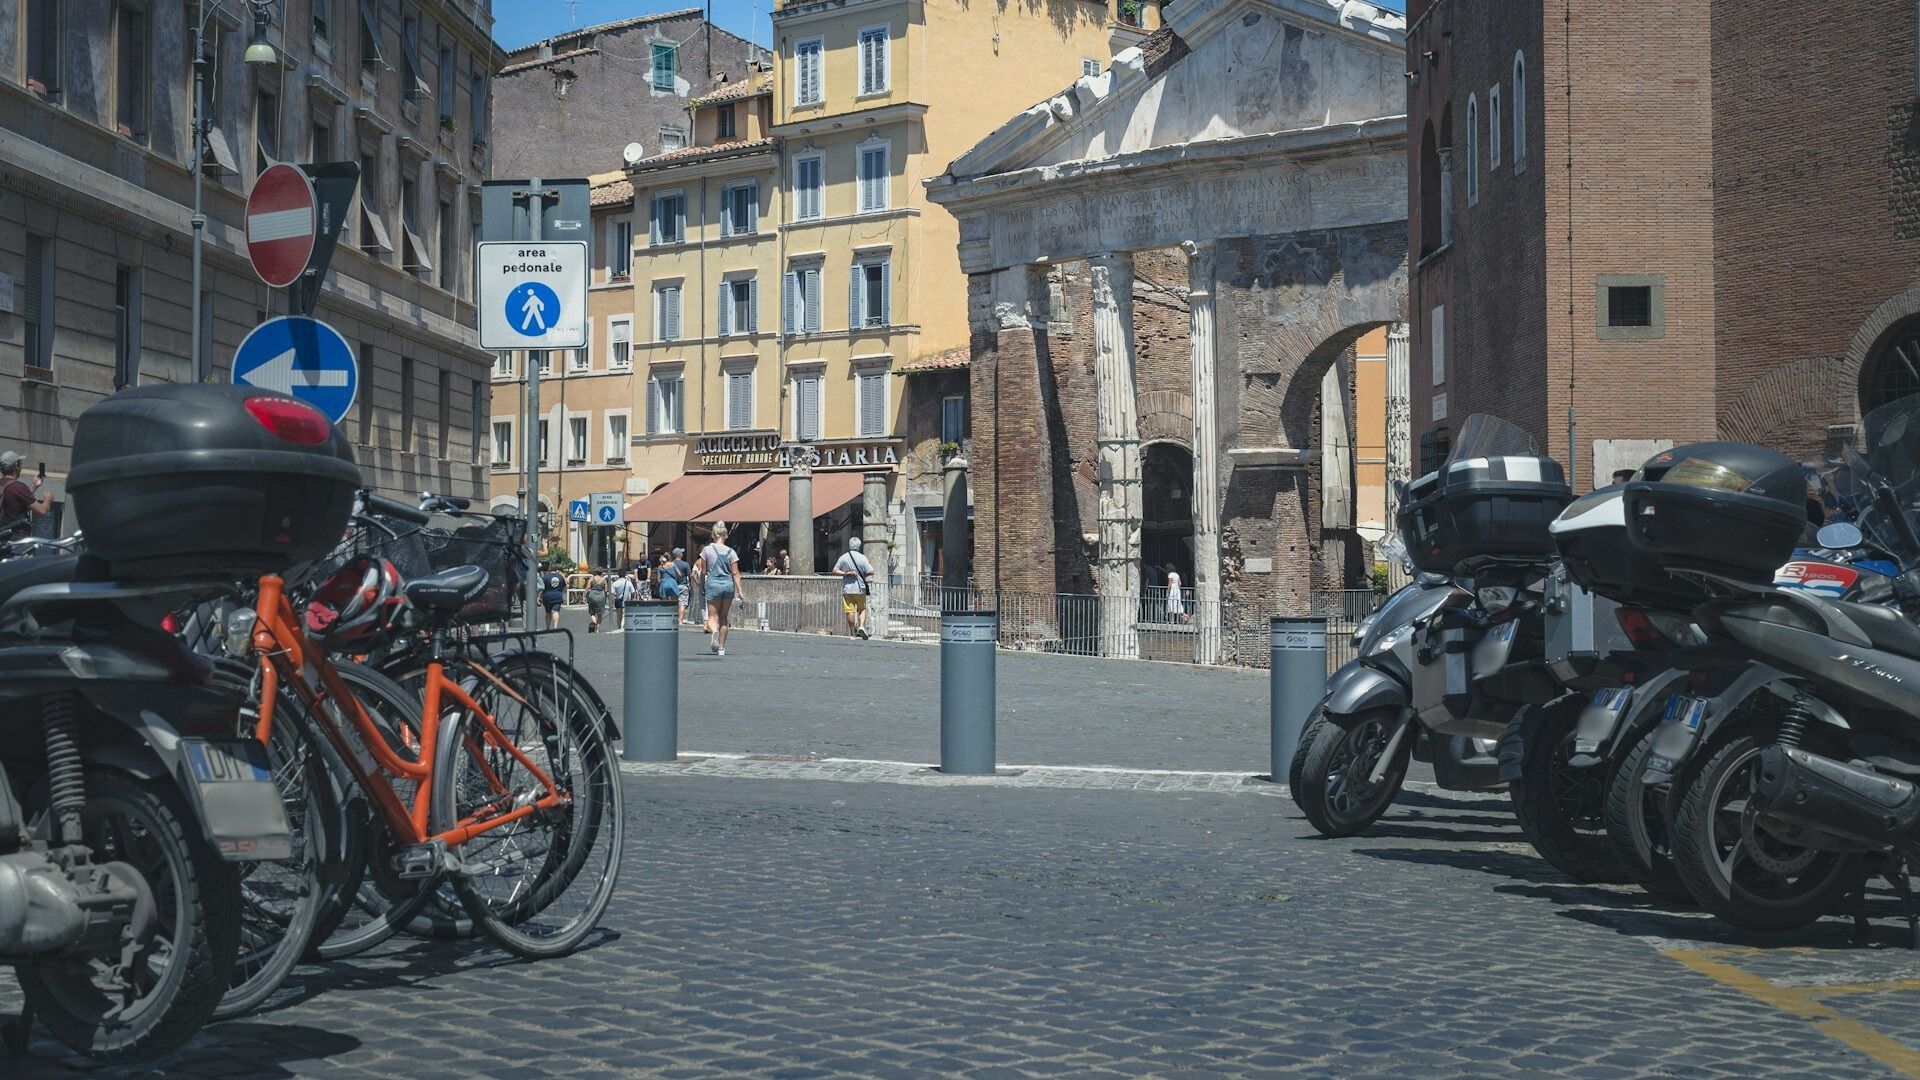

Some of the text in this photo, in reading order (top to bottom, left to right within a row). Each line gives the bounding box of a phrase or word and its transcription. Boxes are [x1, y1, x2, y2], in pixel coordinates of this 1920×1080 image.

[518, 249, 546, 257] area
[503, 262, 563, 274] pedonale
[708, 434, 779, 453] GIGGETTO
[779, 445, 898, 468] HSTARIA
